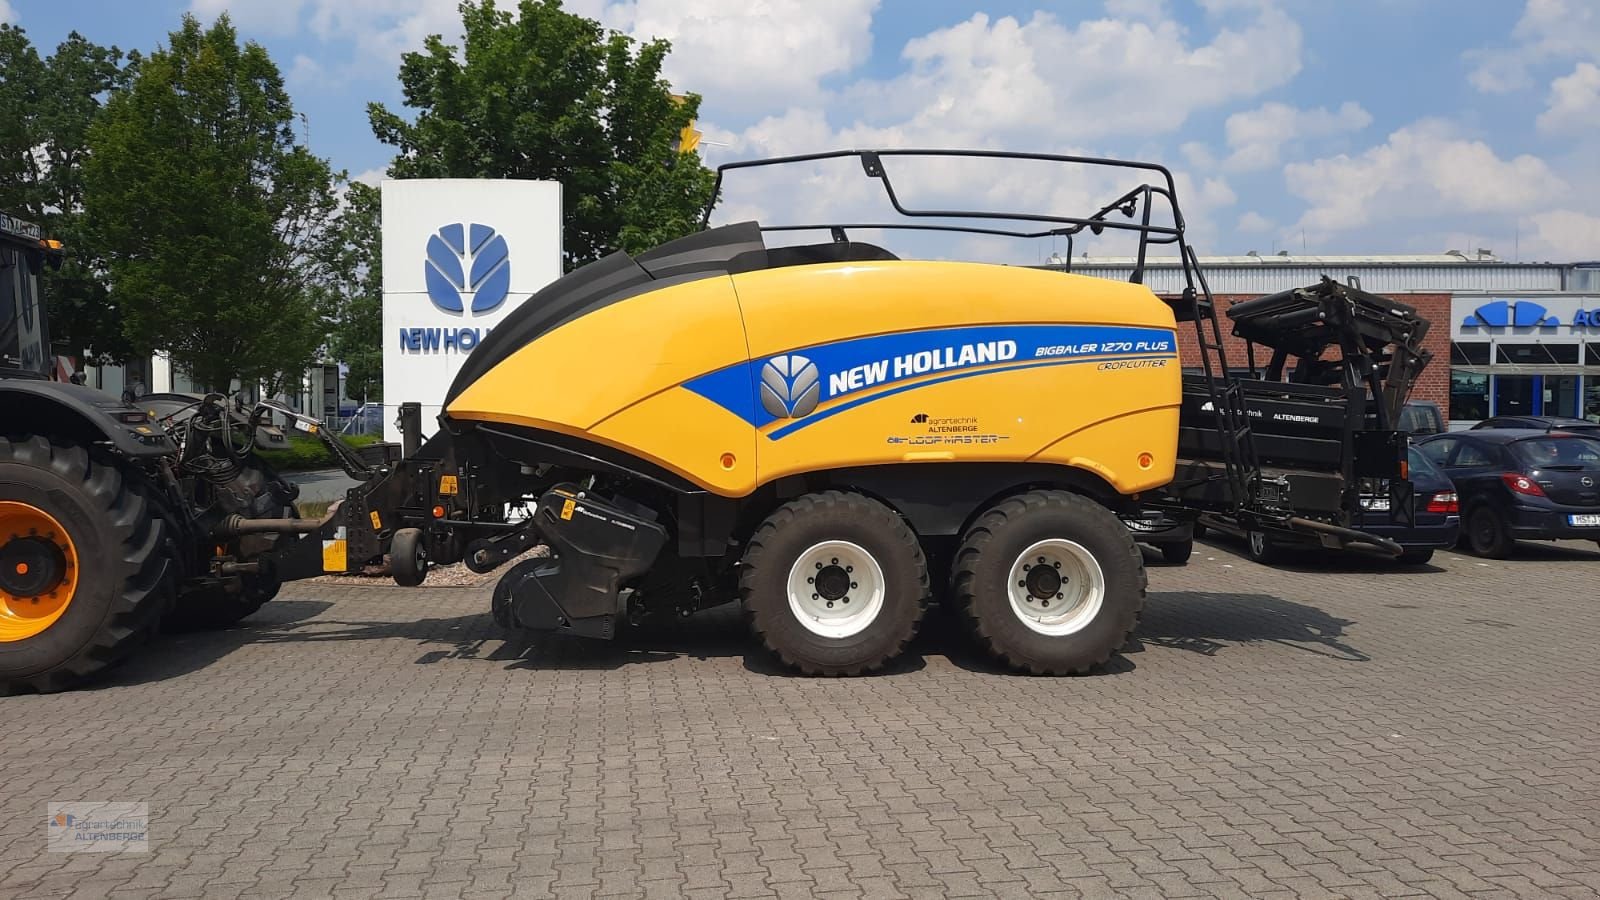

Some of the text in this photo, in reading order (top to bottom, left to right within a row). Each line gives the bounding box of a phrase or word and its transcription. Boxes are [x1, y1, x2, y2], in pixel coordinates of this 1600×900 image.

[399, 327, 441, 351] NEW
[1034, 341, 1169, 357] BIGBALER 1270 PLUS
[829, 340, 1017, 397] NEW HOLLAND
[1097, 359, 1167, 371] CROPCUTTER
[928, 416, 978, 426] agrartechnik
[1273, 413, 1320, 424] ALTENBERGE
[928, 425, 978, 433] ALTENBERGE
[908, 434, 999, 445] LOOP MASTER
